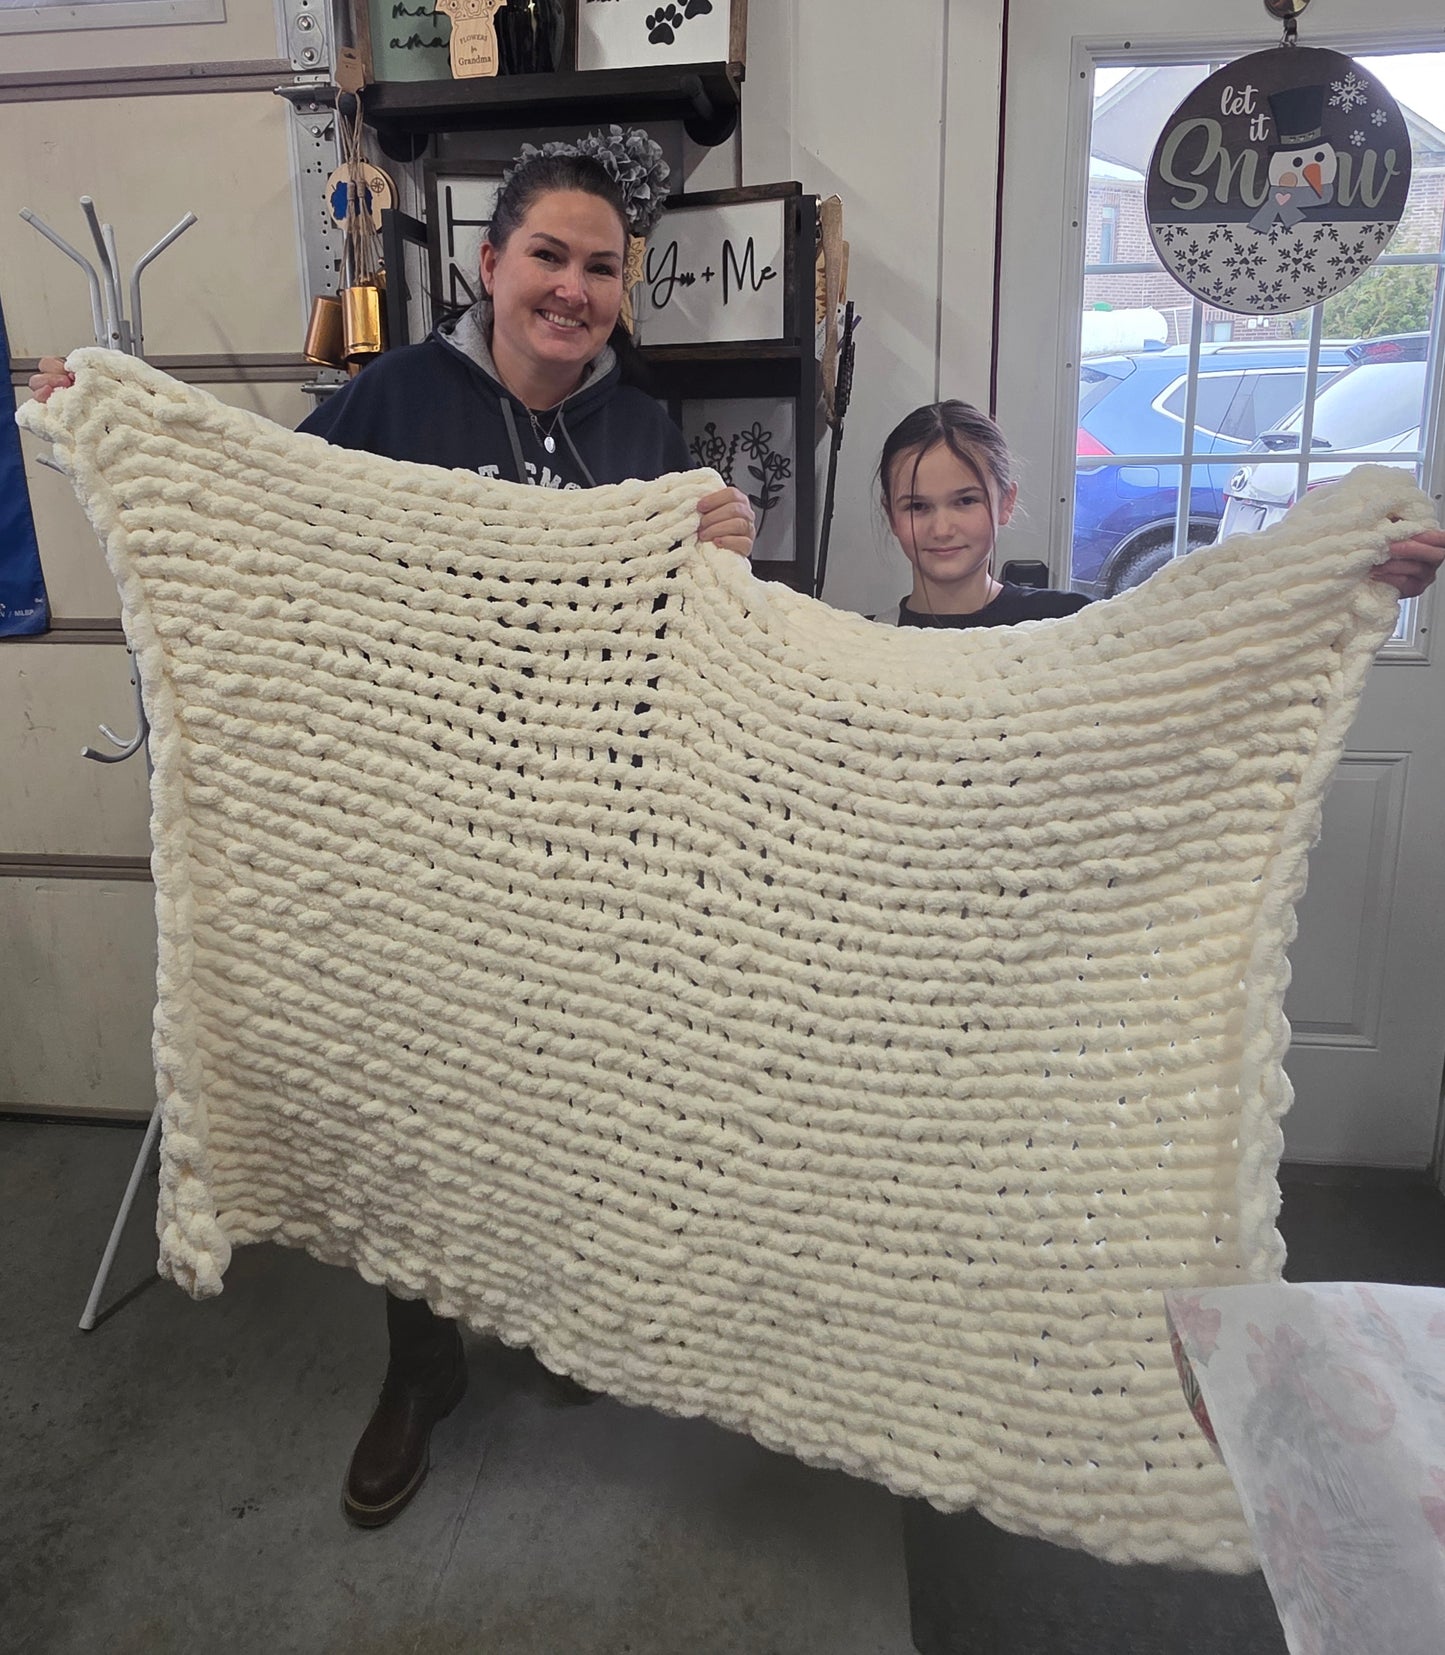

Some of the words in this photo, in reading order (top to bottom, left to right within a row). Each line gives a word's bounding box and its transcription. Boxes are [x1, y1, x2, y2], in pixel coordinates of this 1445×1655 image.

[459, 34, 488, 44] FLOWERS
[458, 54, 492, 66] Grandma
[1220, 85, 1259, 116] let
[1250, 113, 1271, 142] it
[646, 240, 696, 309] You
[722, 236, 777, 306] Me
